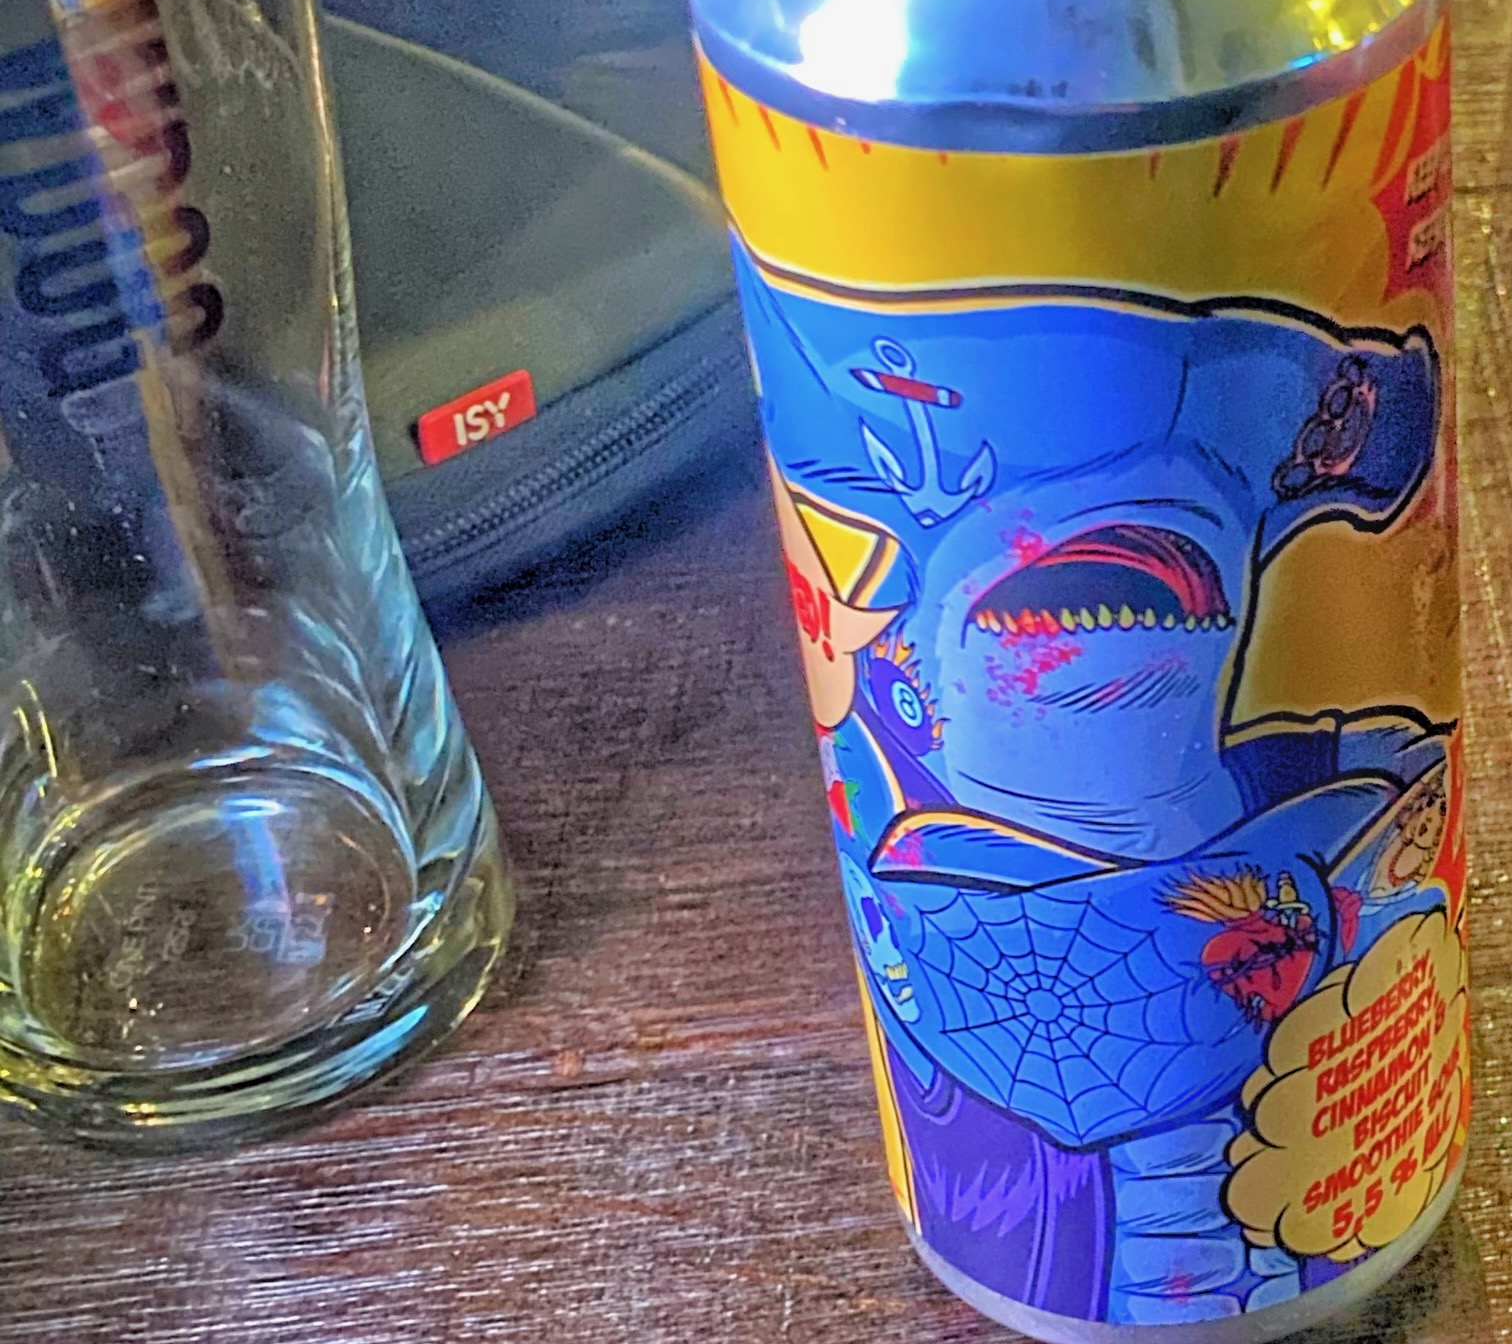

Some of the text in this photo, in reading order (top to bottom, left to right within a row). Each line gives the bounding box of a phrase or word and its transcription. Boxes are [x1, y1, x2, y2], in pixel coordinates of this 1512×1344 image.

[453, 391, 511, 446] ISY
[1307, 948, 1435, 1071] BLUEBERRY,
[1316, 981, 1438, 1103] RASPBERRY,
[1312, 1024, 1432, 1138] CINNAMON
[1353, 1052, 1432, 1151] BISCUIT
[1303, 1098, 1425, 1213] SMOOTHIE
[1332, 1178, 1385, 1240] 5,5
